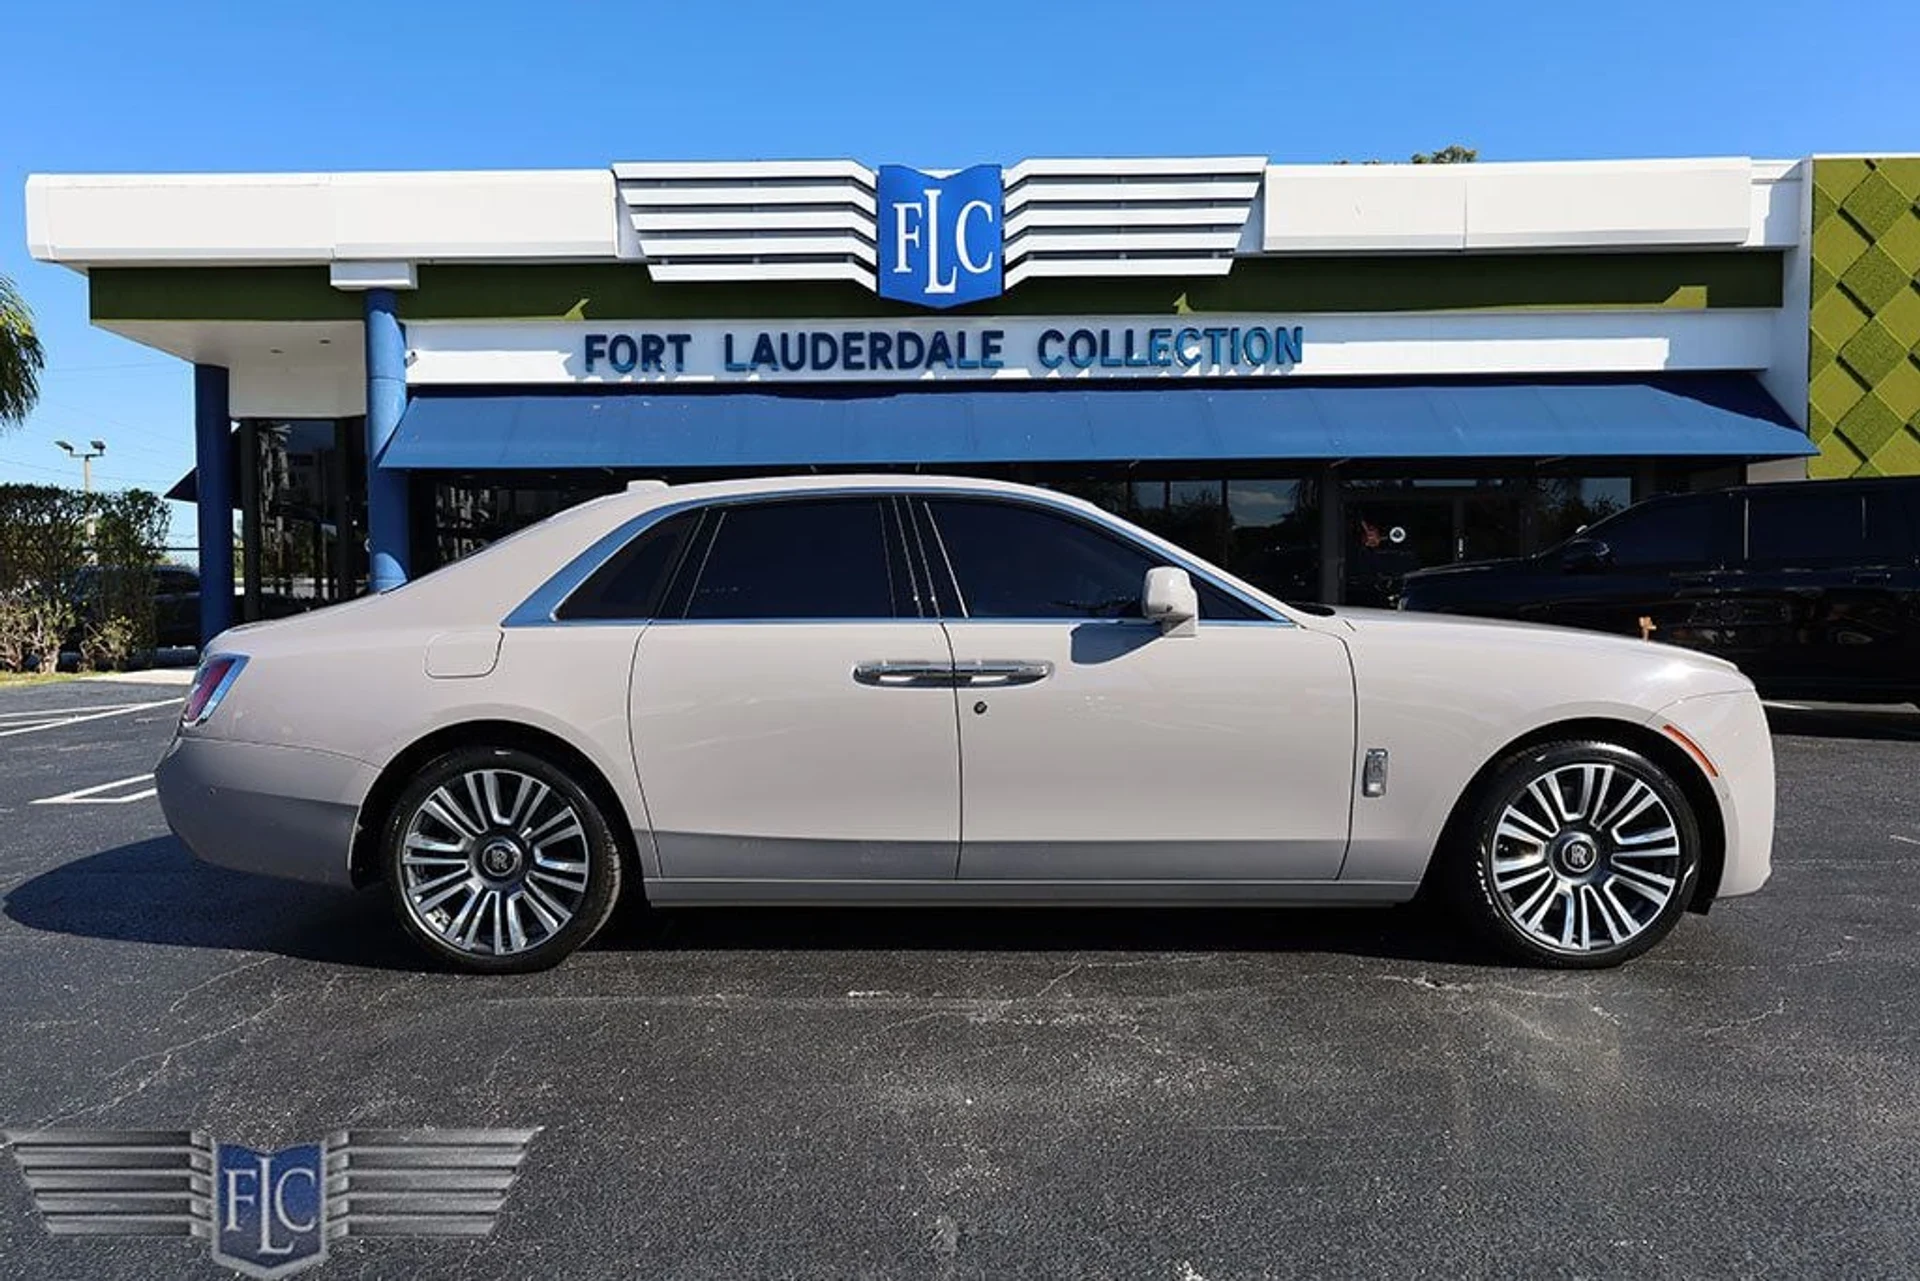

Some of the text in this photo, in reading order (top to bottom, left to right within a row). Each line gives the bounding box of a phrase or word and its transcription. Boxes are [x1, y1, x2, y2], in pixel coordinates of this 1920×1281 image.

[892, 189, 993, 294] FLC
[584, 326, 1303, 373] FORT LAUDERDALE COLLECTION
